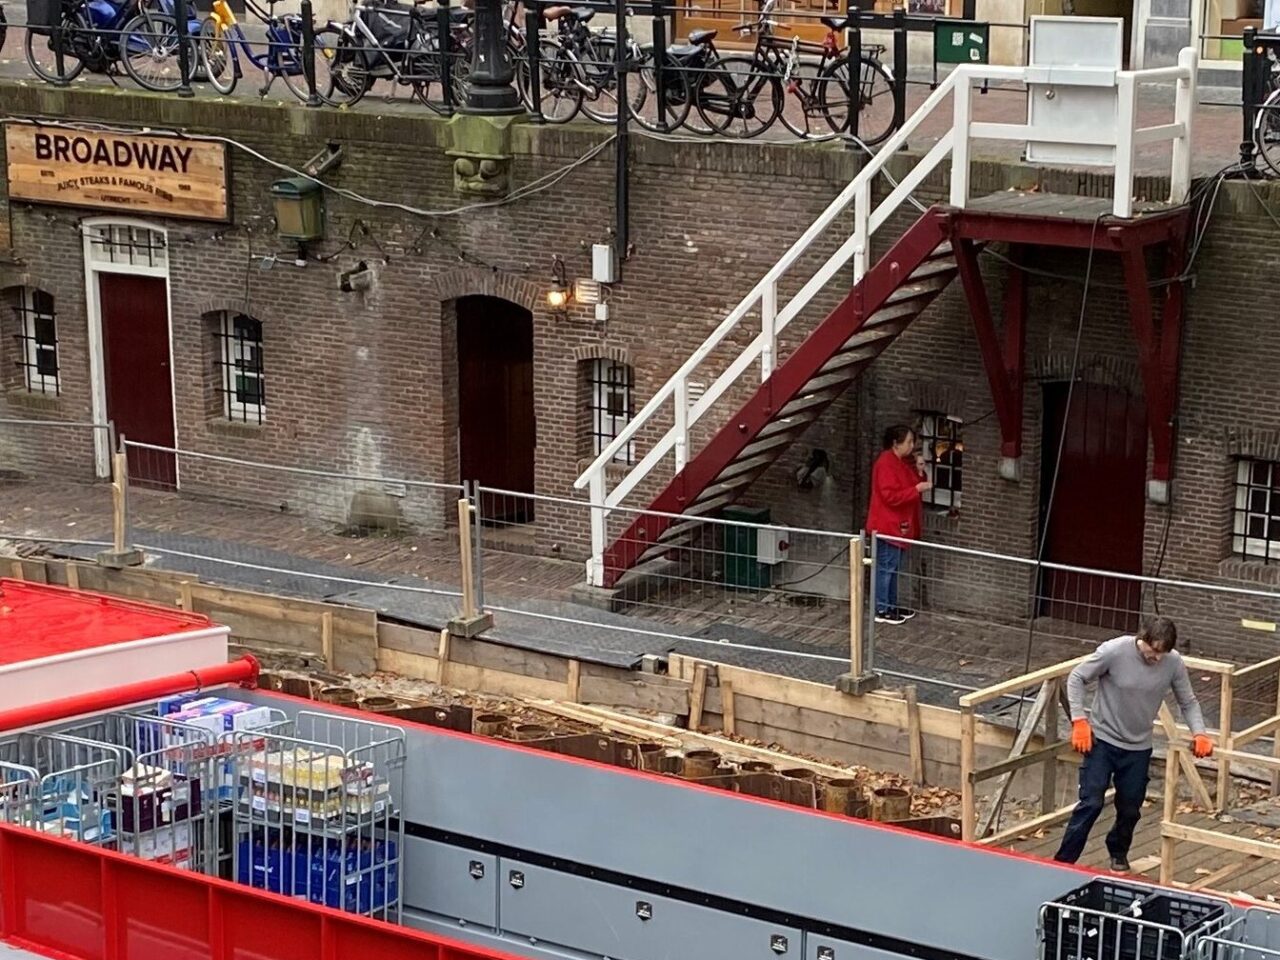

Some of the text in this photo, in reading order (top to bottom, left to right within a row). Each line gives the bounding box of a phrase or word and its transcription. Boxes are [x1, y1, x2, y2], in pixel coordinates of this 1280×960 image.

[35, 134, 192, 173] BROADWAY
[57, 179, 80, 191] JUICY
[80, 176, 110, 185] STEAKS
[119, 177, 153, 193] FAMOUS
